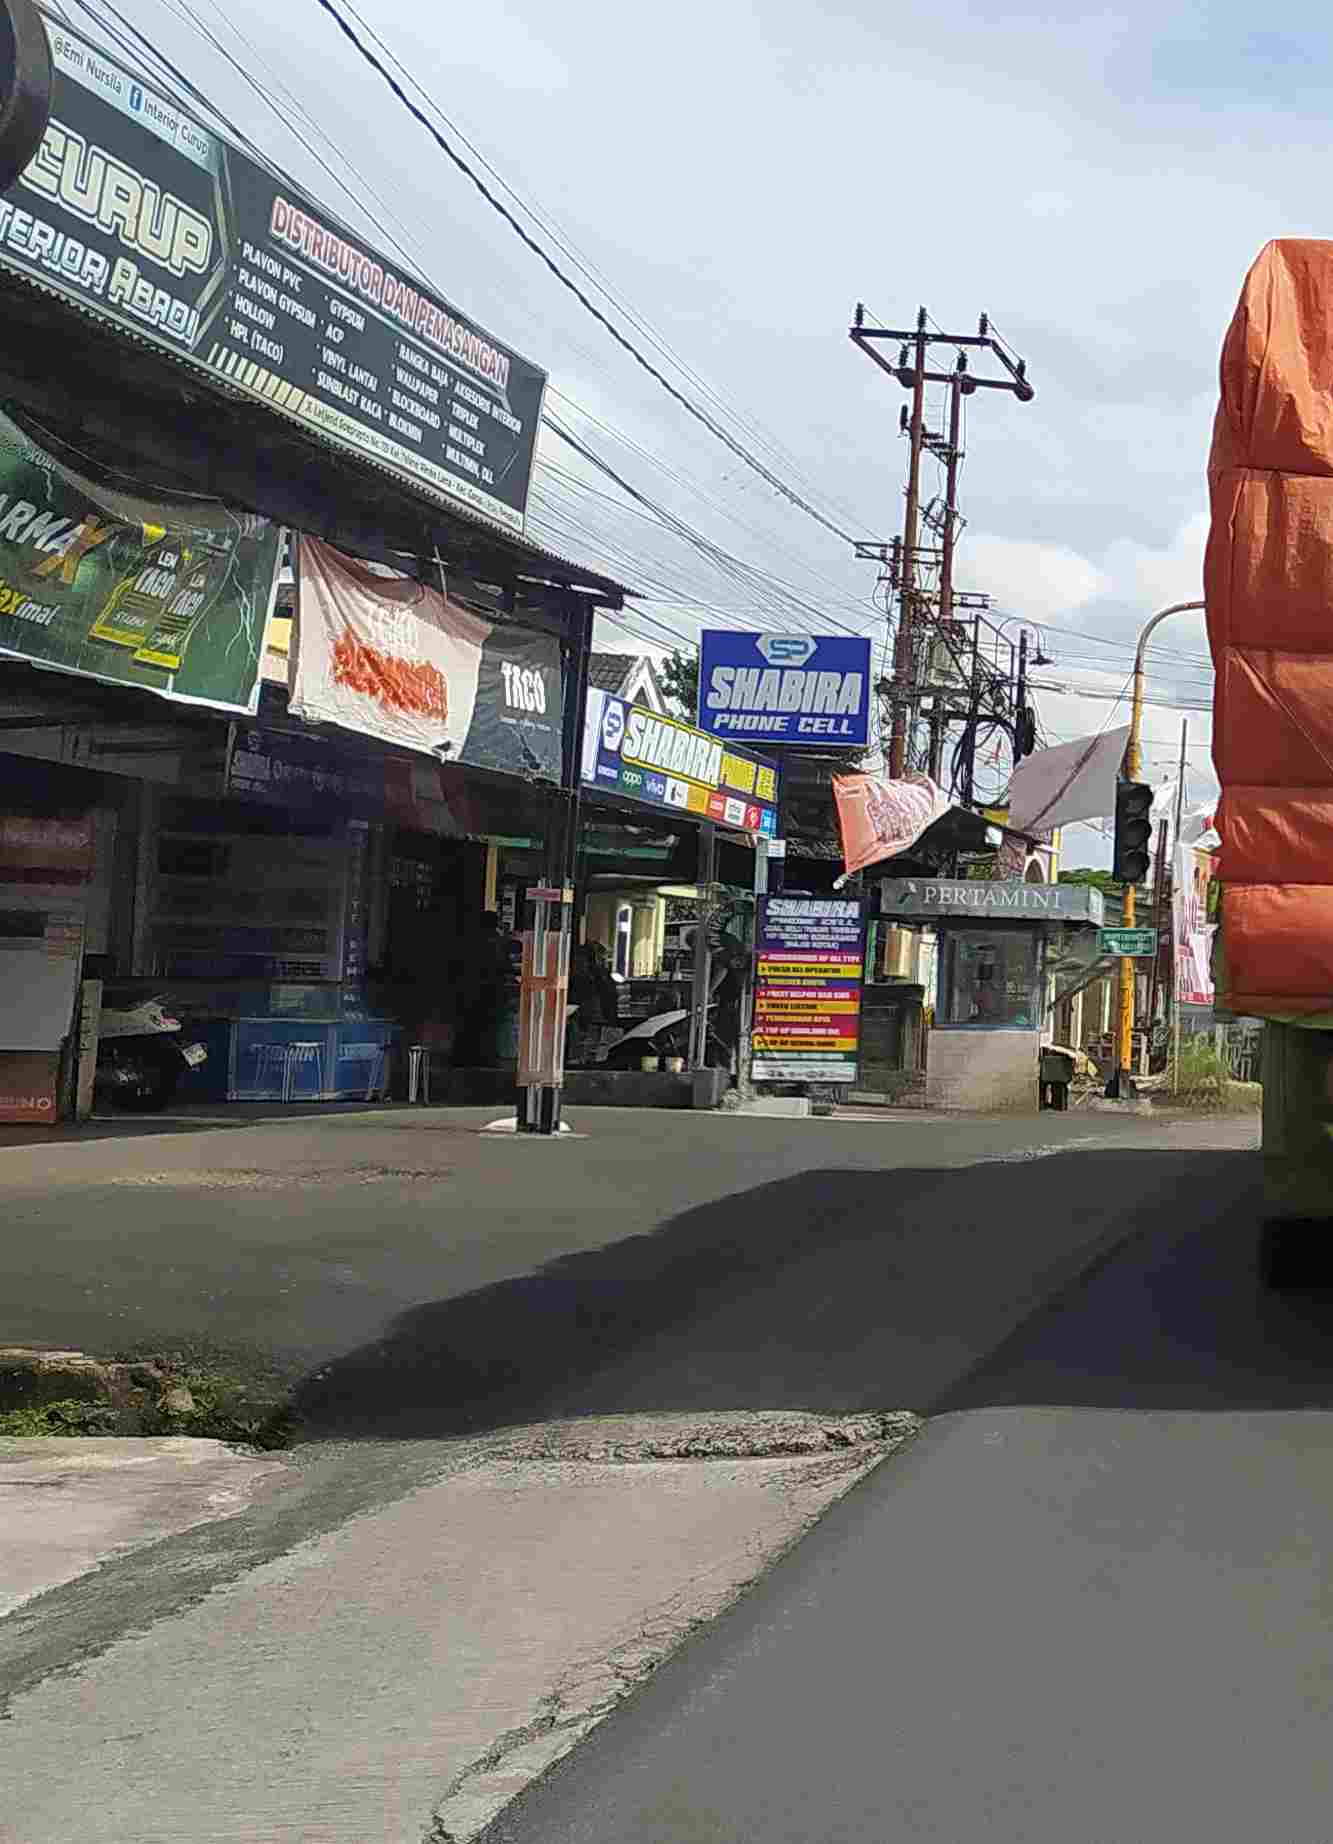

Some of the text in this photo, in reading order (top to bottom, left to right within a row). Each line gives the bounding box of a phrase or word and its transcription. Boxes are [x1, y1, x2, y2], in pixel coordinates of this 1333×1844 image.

[144, 98, 209, 160] Interior Curup
[243, 242, 302, 292] PLAVON PVC
[271, 195, 511, 388] DISTRIBUTOR DAN PEMASANGAN
[107, 256, 200, 346] ABADI
[235, 293, 276, 330] HOLLOW
[239, 268, 316, 329] PLAVON GYPSUM
[329, 299, 366, 332] GYPSUM
[230, 319, 284, 364] HPL (TACO)
[396, 366, 439, 405] WALLPAPER
[500, 659, 546, 714] TACO
[706, 665, 864, 715] SHABIRA
[713, 713, 854, 734] PHONE CELL
[623, 709, 723, 789] SHABIRA
[923, 886, 1062, 909] PERTAMINI
